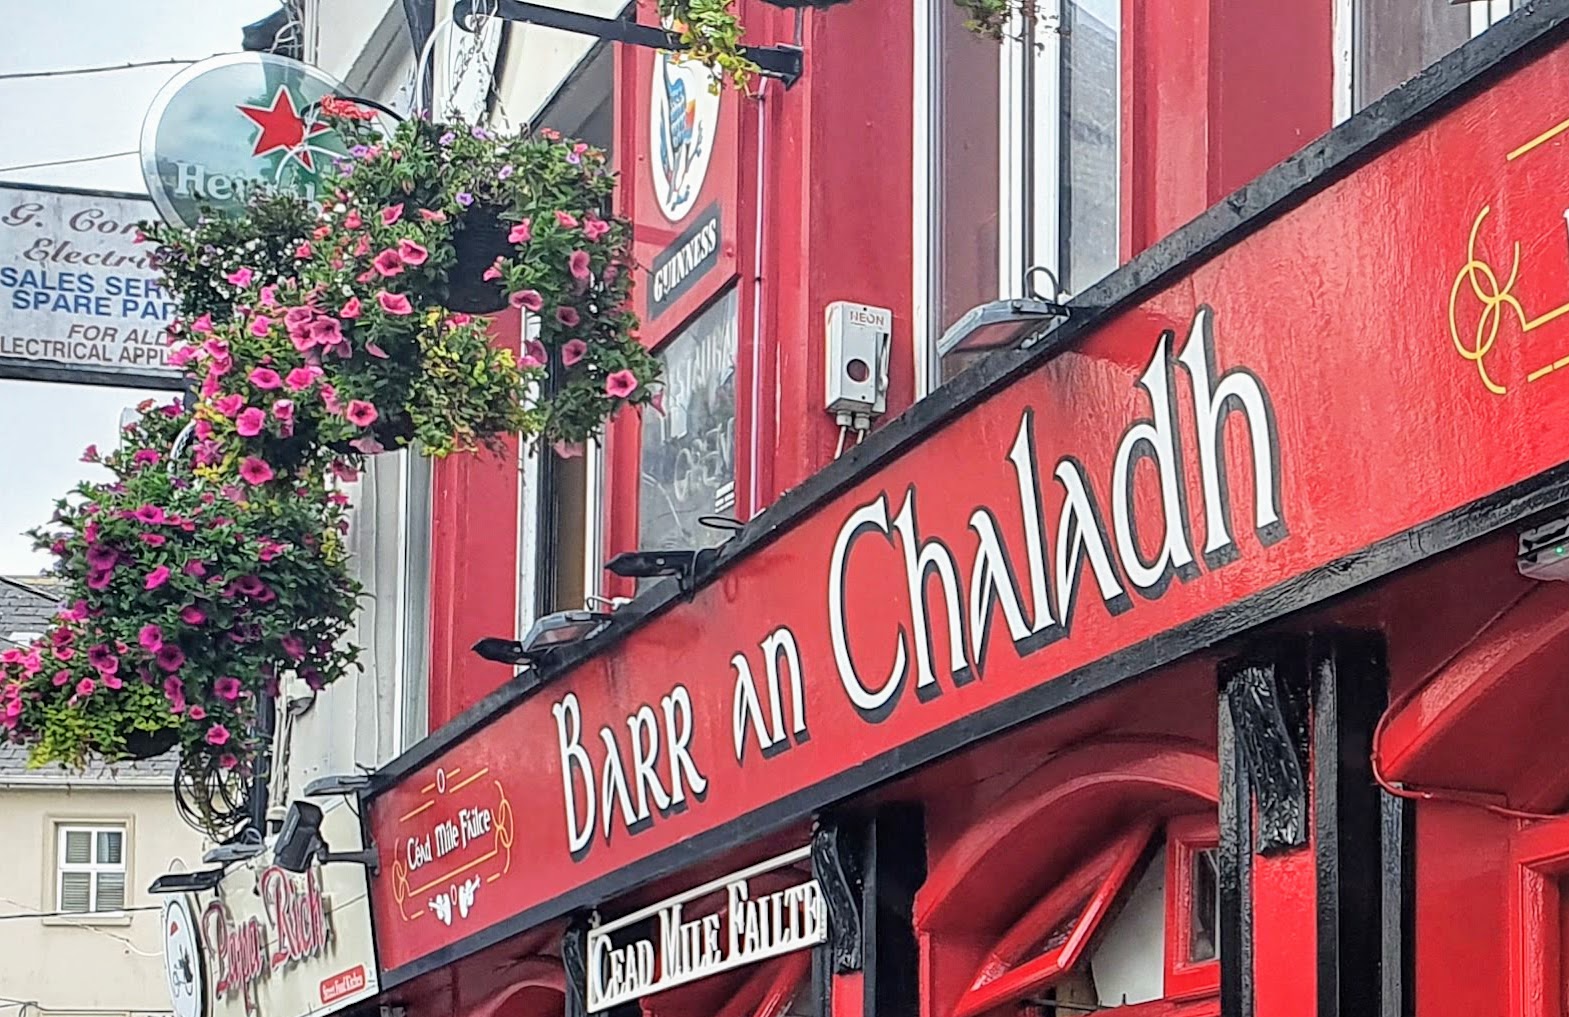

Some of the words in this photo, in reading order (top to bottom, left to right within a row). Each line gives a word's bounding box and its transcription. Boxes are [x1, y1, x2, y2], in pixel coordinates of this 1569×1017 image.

[2, 203, 44, 227] G.
[23, 238, 147, 268] Electri
[653, 217, 717, 303] GUINNESS
[0, 267, 94, 294] SALES
[105, 277, 162, 299] SER
[12, 290, 112, 316] SPARE
[67, 324, 118, 342] FOR
[850, 311, 884, 326] NEON
[0, 336, 112, 361] LECTRICAL
[119, 346, 169, 366] APPL
[731, 627, 808, 764] an
[828, 304, 1286, 716] Chaladh
[592, 932, 655, 1000] CEAD
[658, 903, 722, 980] MILE
[726, 879, 821, 960] FAILTE
